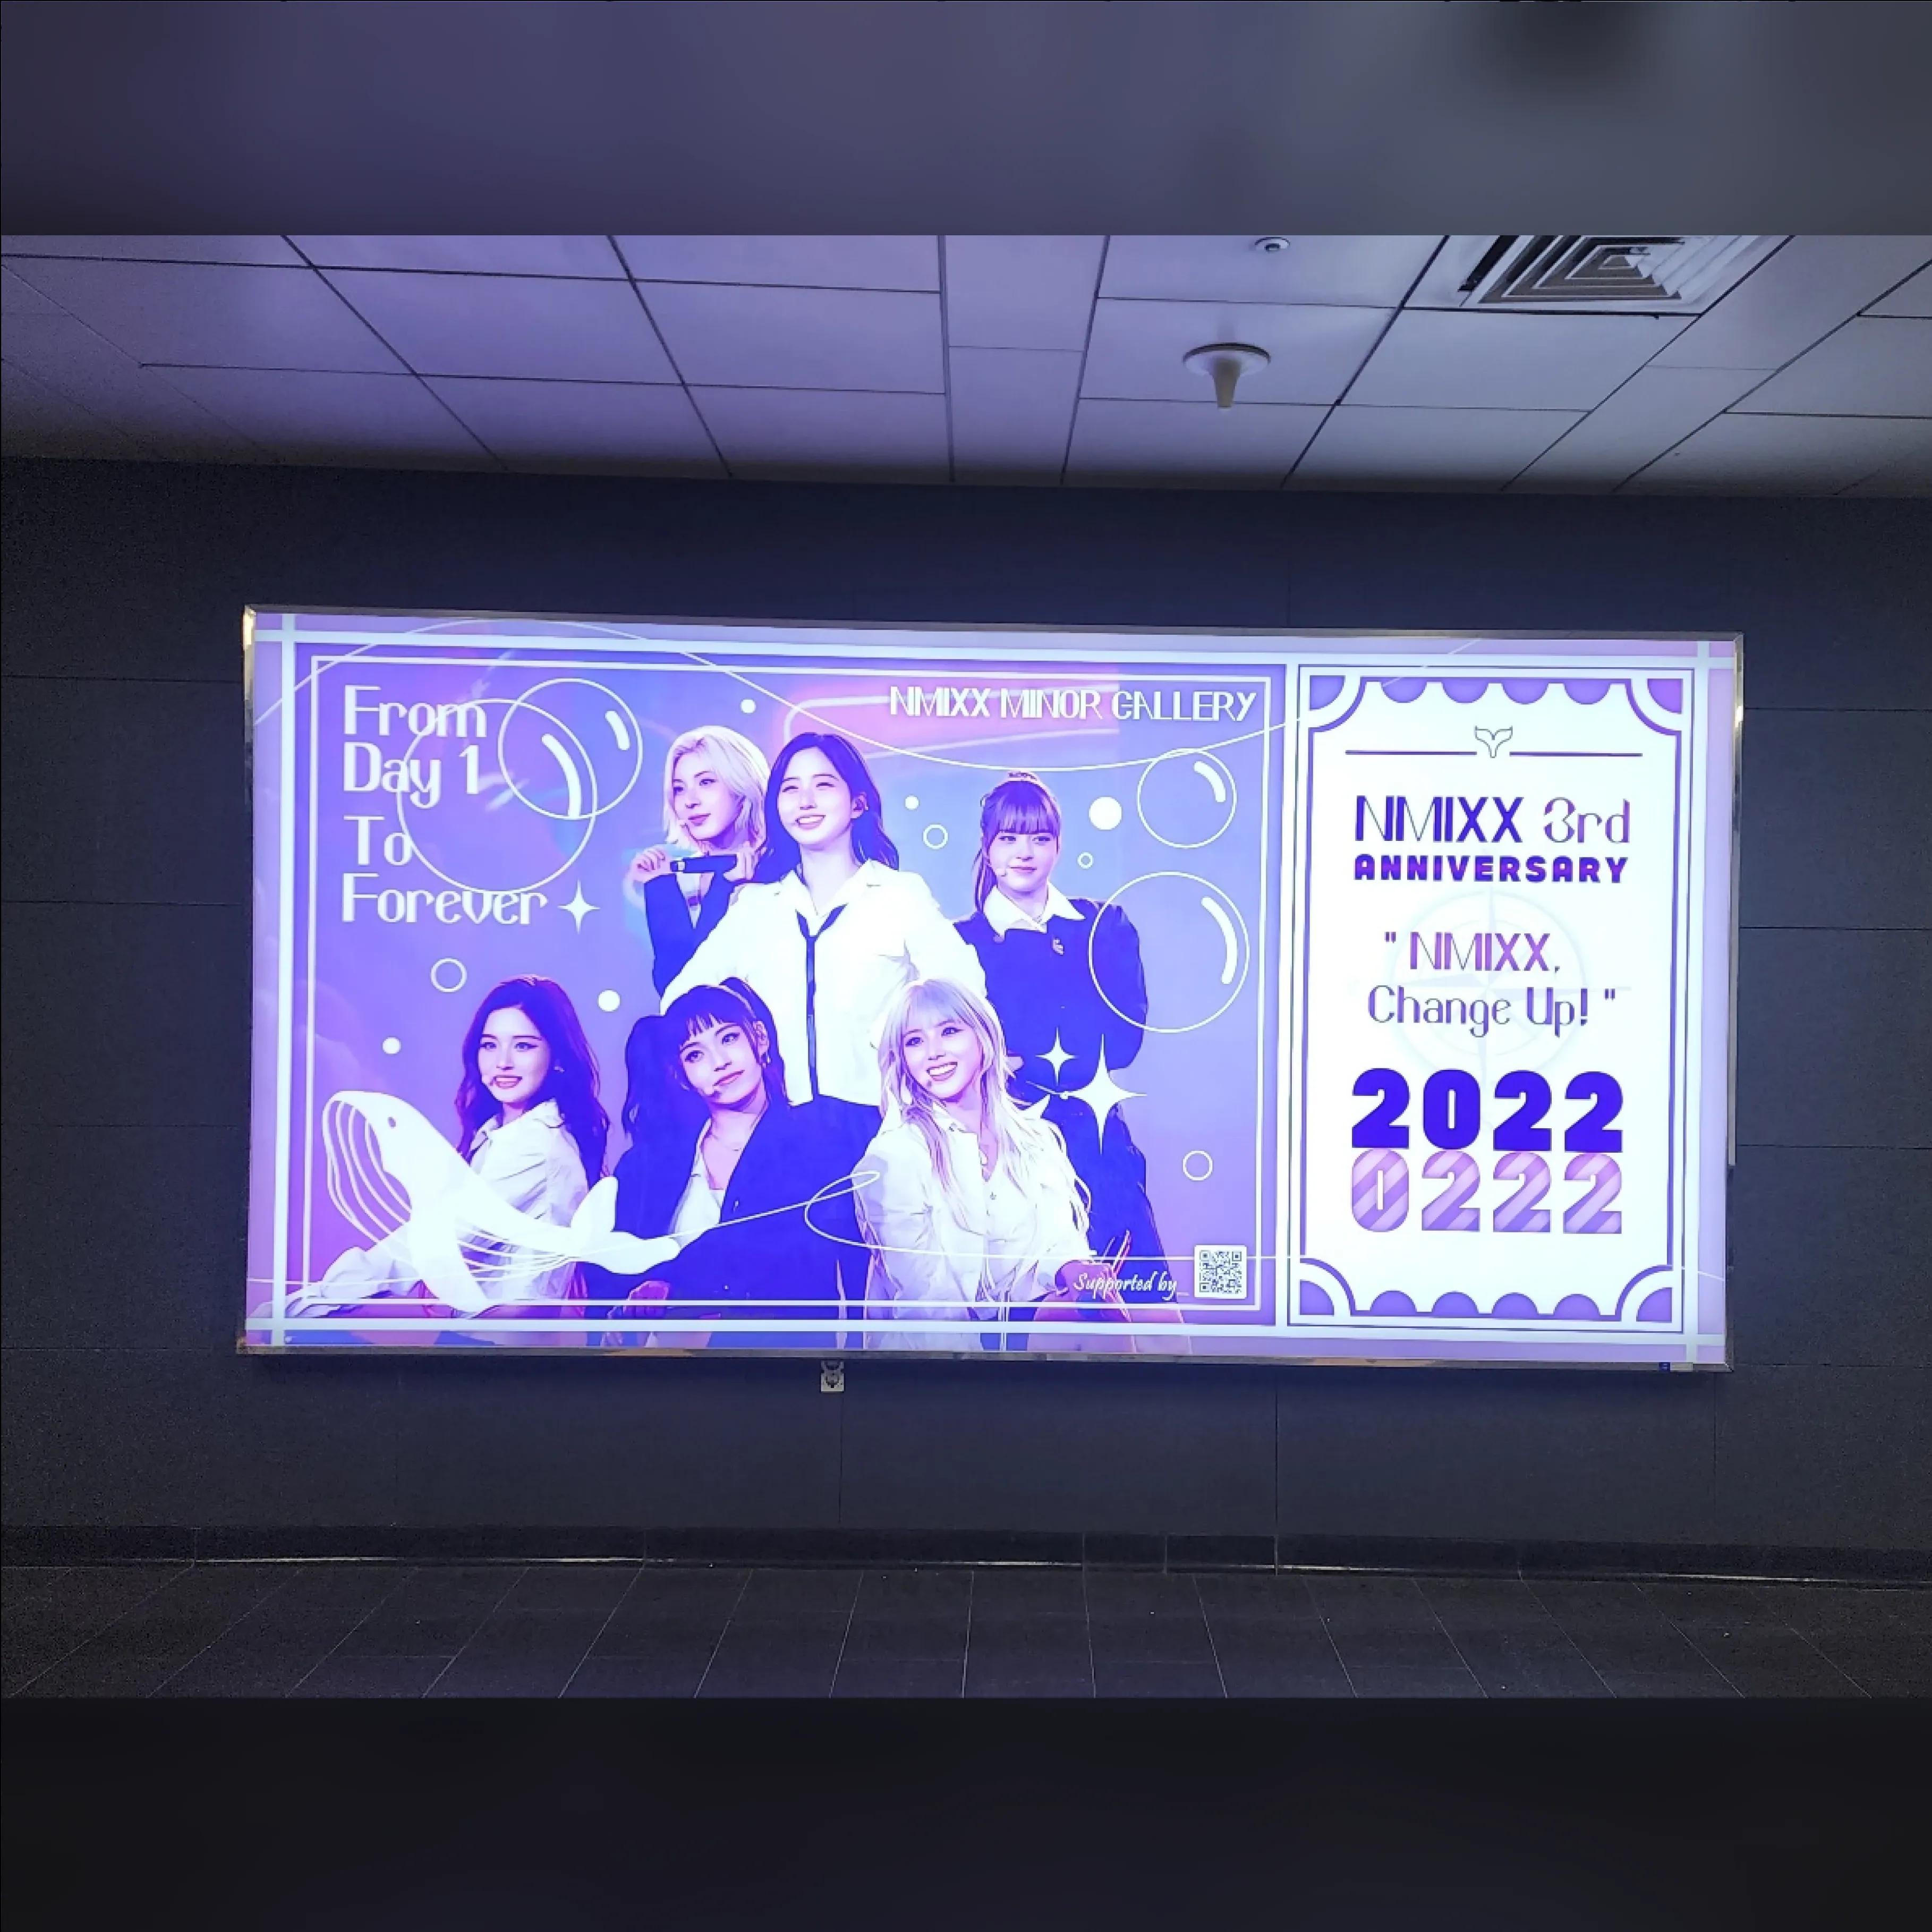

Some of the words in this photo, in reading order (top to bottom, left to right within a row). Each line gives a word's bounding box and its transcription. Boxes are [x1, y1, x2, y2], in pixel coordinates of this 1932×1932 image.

[343, 685, 487, 737] From
[889, 685, 991, 718] NMIXX
[1000, 688, 1103, 719] MINOR
[1111, 690, 1257, 721] GALLERY
[343, 742, 441, 809] Day
[459, 745, 479, 794] 1
[343, 816, 414, 865] To
[1355, 795, 1524, 842] NMIXX
[1543, 797, 1630, 844] 3rd
[1354, 854, 1628, 883] ANNIVERSARY
[342, 873, 548, 924] Forever
[1368, 985, 1511, 1037] Change
[1527, 987, 1587, 1037] Up!
[1352, 1068, 1623, 1152] 2022
[1352, 1148, 1622, 1233] 0222
[1074, 1271, 1158, 1299] Supported
[1158, 1271, 1177, 1301] by
